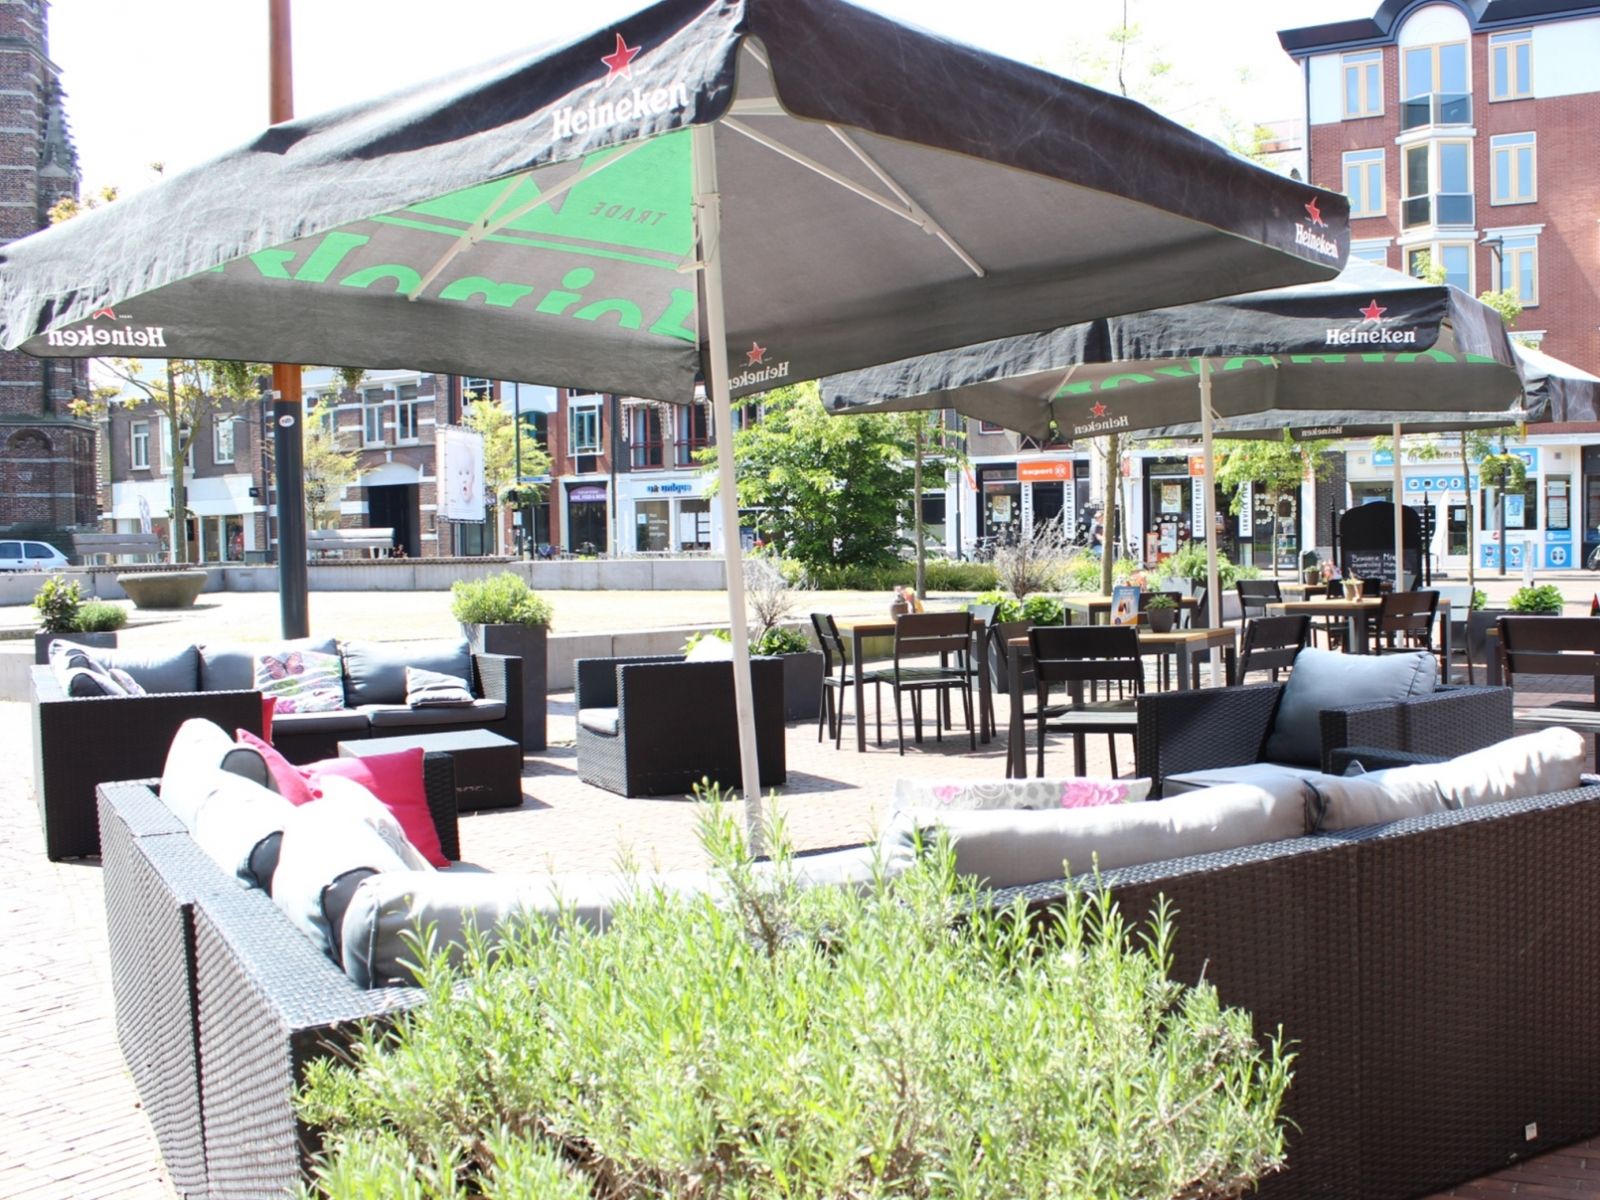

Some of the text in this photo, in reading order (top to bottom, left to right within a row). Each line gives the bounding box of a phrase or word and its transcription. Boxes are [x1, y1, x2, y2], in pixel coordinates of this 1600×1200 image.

[551, 81, 690, 141] Heineken
[1295, 222, 1338, 258] Heineken
[1325, 327, 1416, 345] Heineken
